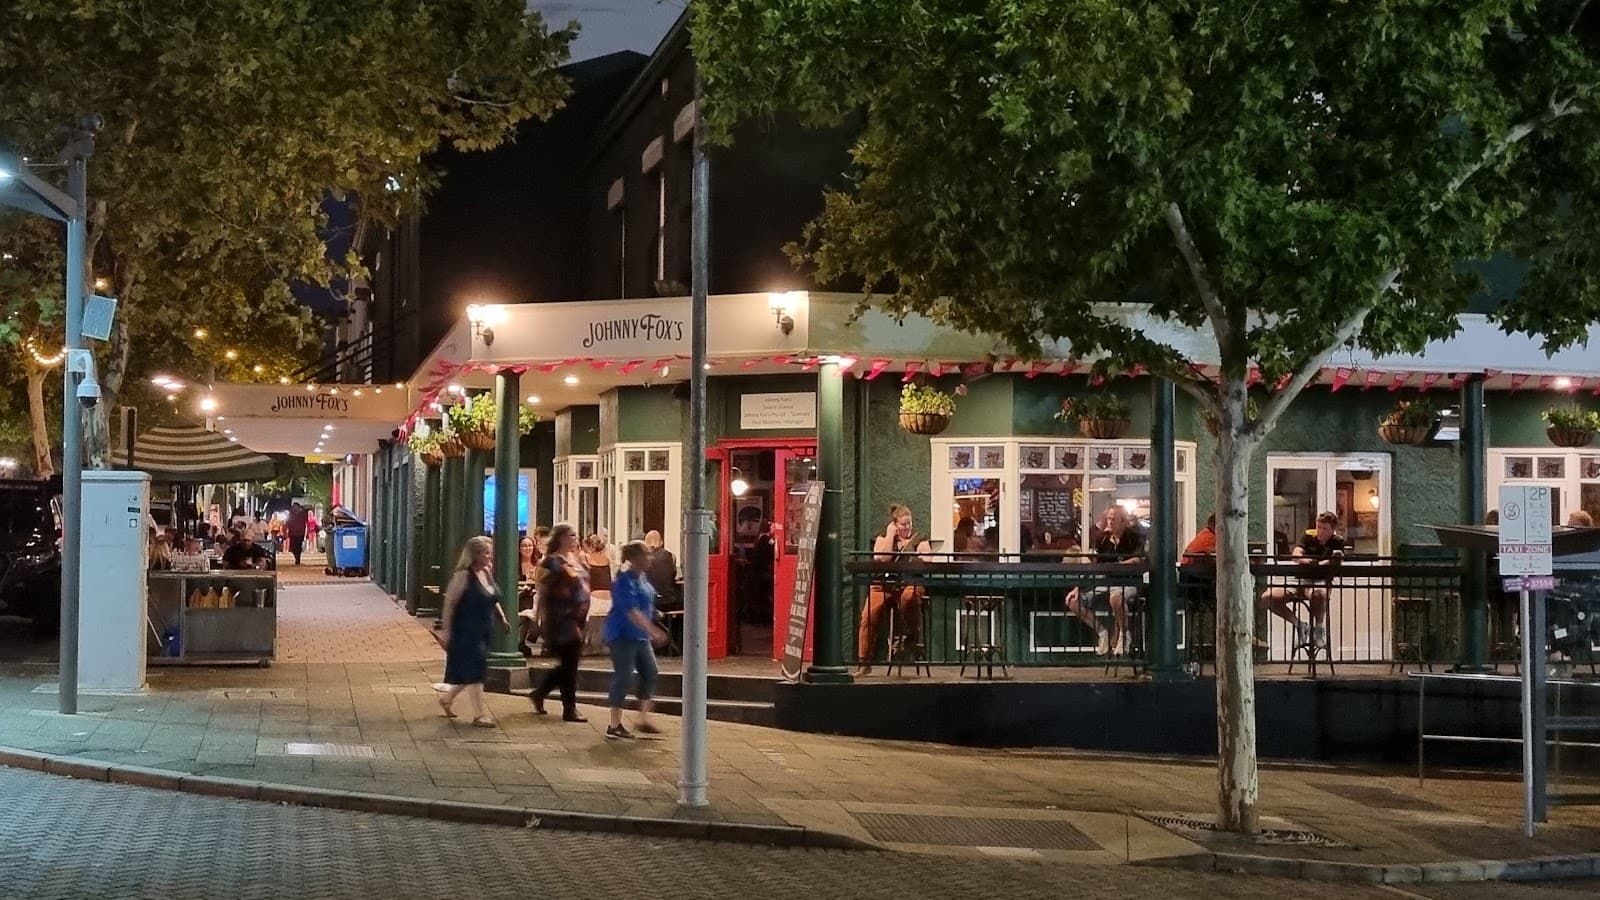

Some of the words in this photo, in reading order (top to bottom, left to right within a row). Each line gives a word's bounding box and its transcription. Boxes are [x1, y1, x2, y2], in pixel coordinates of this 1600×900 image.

[583, 319, 639, 348] JOHNNY
[640, 313, 684, 341] FOX'S
[271, 395, 315, 412] JOHNNY
[1530, 487, 1547, 501] 2P
[1502, 545, 1523, 553] TAXI
[1525, 545, 1550, 553] ZONE
